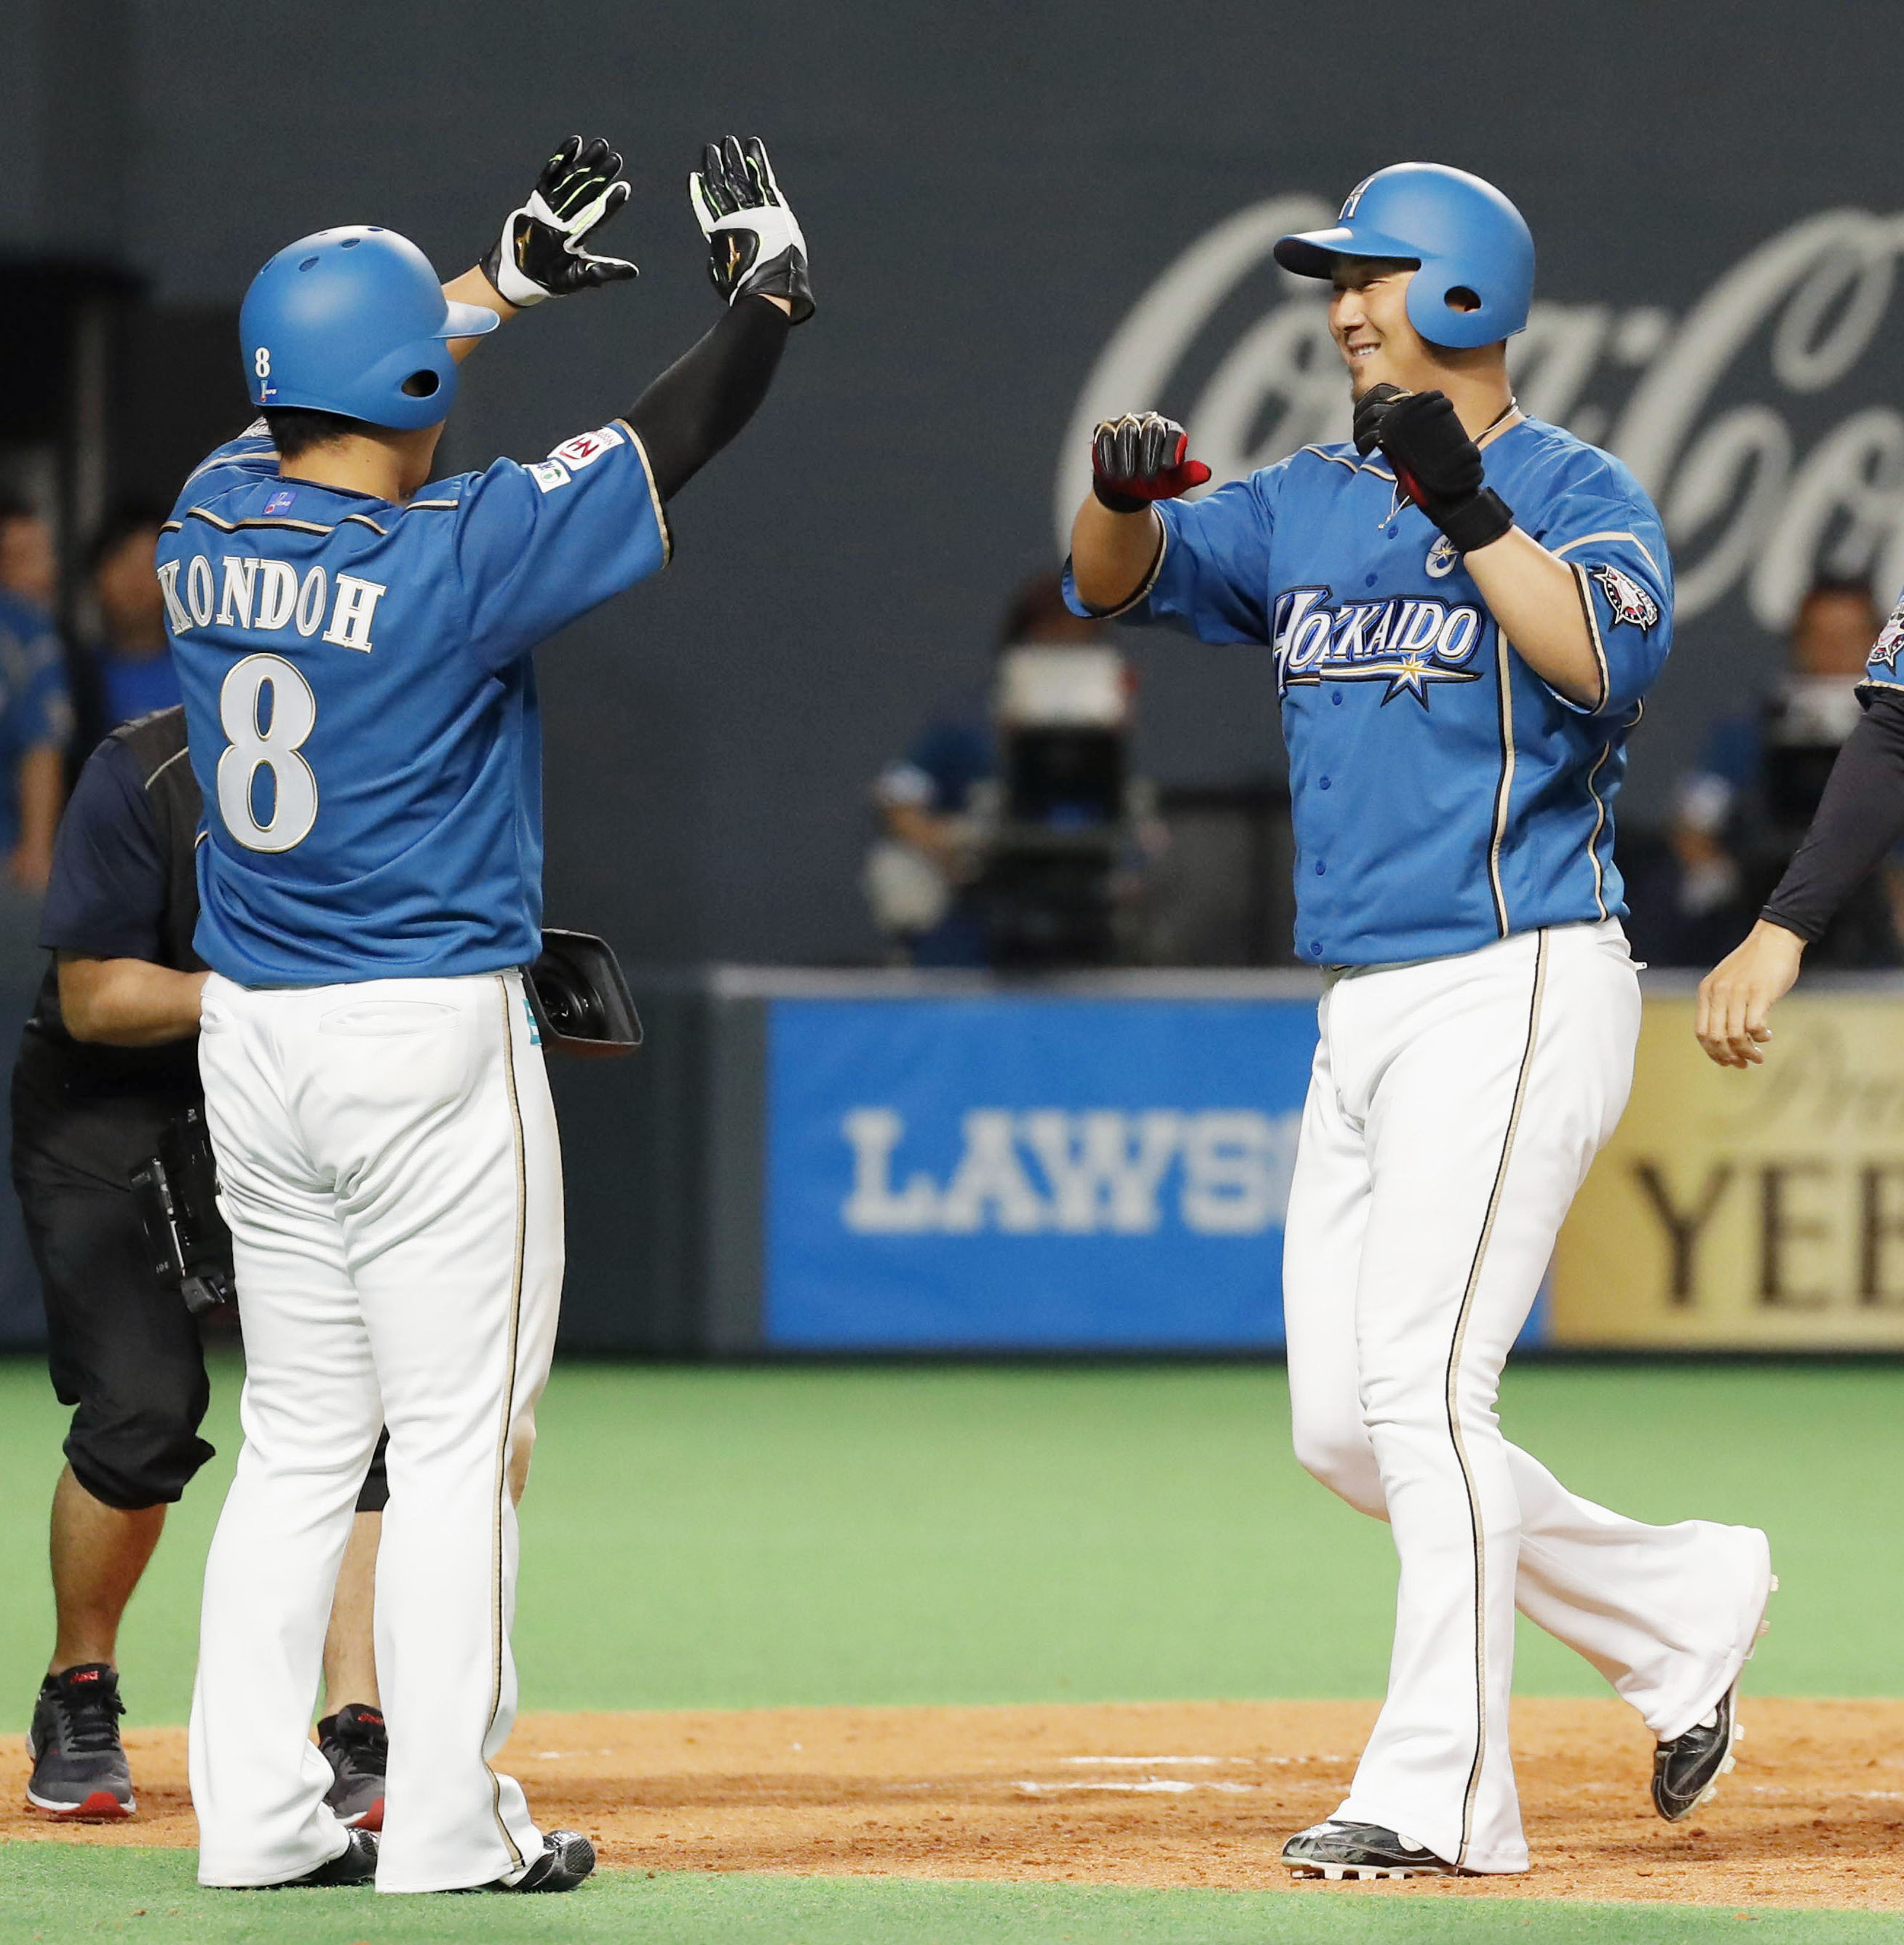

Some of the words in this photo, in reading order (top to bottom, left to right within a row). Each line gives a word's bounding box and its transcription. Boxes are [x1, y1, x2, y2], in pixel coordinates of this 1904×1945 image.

[255, 346, 271, 378] 8
[156, 555, 386, 653] KONDOH
[1274, 585, 1483, 697] HOKKAIDO
[218, 652, 318, 853] 8
